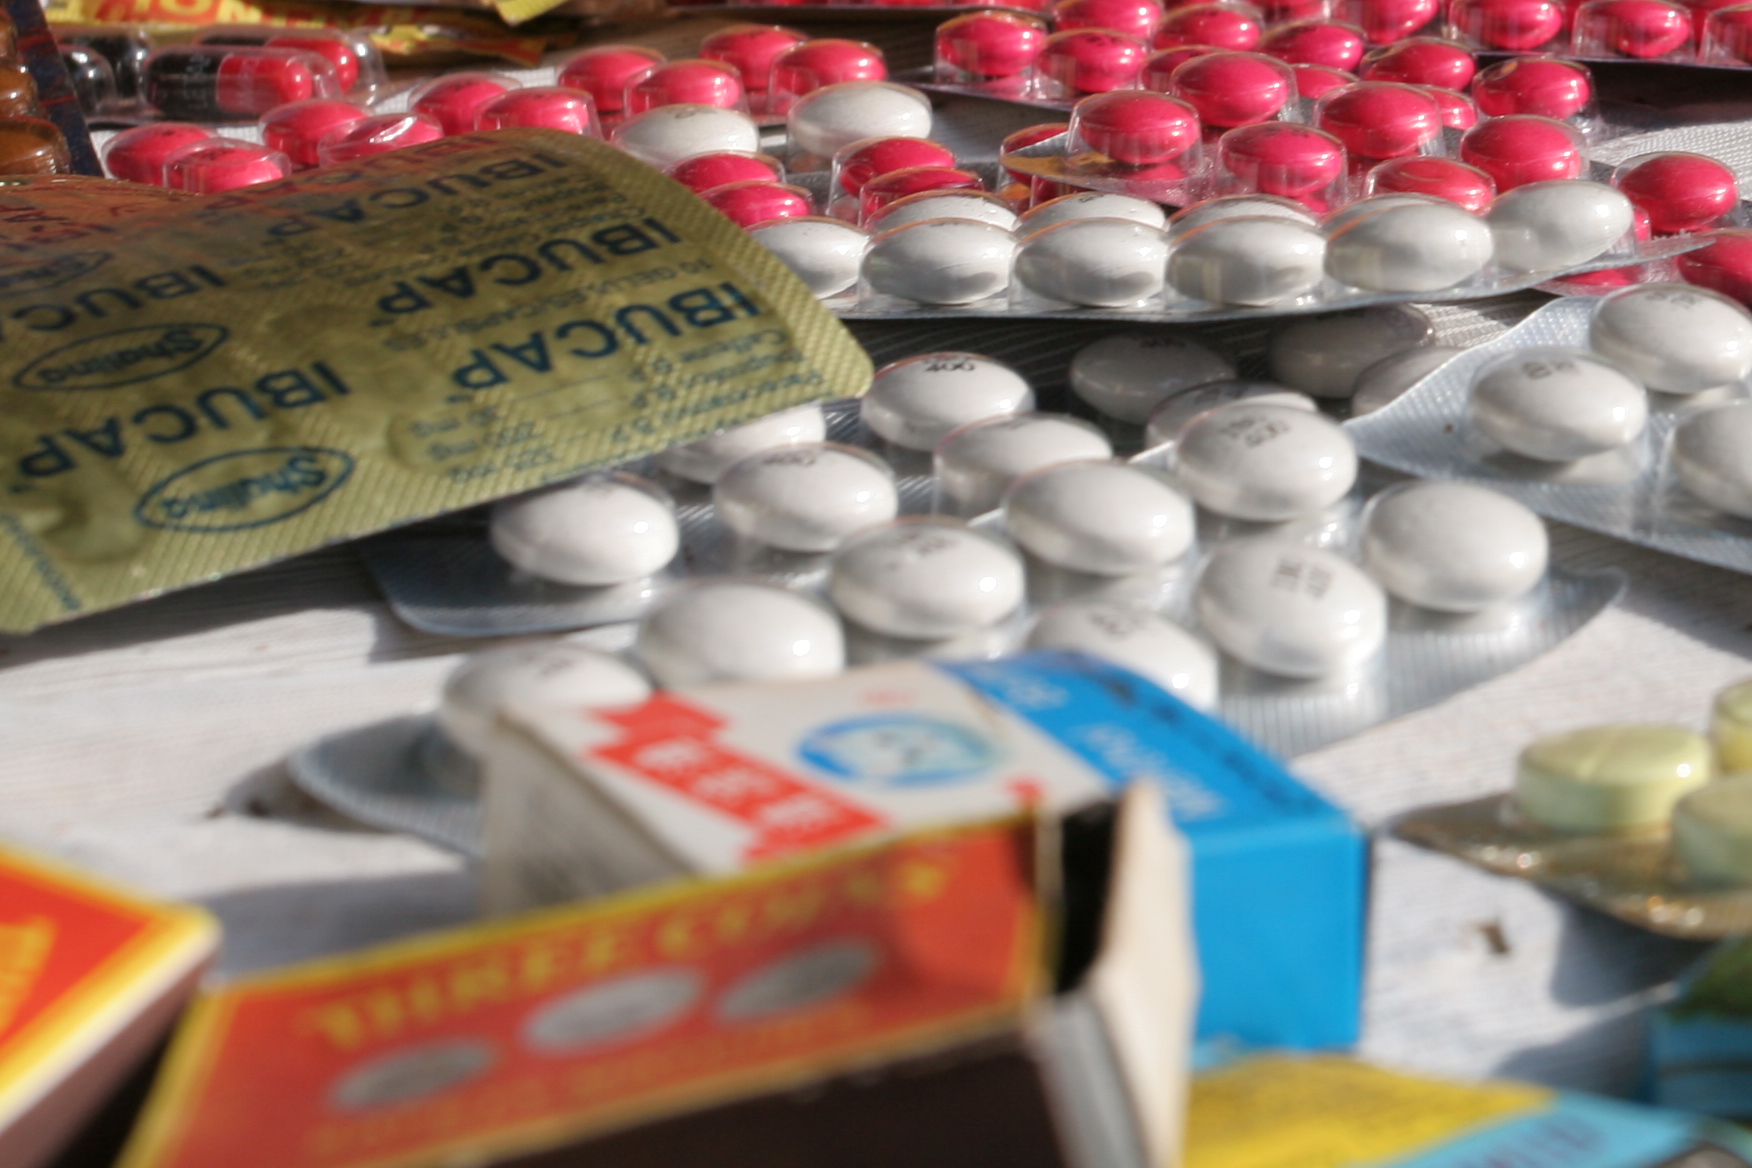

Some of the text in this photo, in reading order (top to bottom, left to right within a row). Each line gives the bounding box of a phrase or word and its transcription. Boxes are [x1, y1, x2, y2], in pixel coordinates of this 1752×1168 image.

[309, 148, 565, 227] IBUCAP
[377, 215, 683, 315] IBUCAP
[453, 280, 765, 392] IBUCAP
[18, 359, 351, 478] IBUCAP
[163, 452, 332, 523] Shalina
